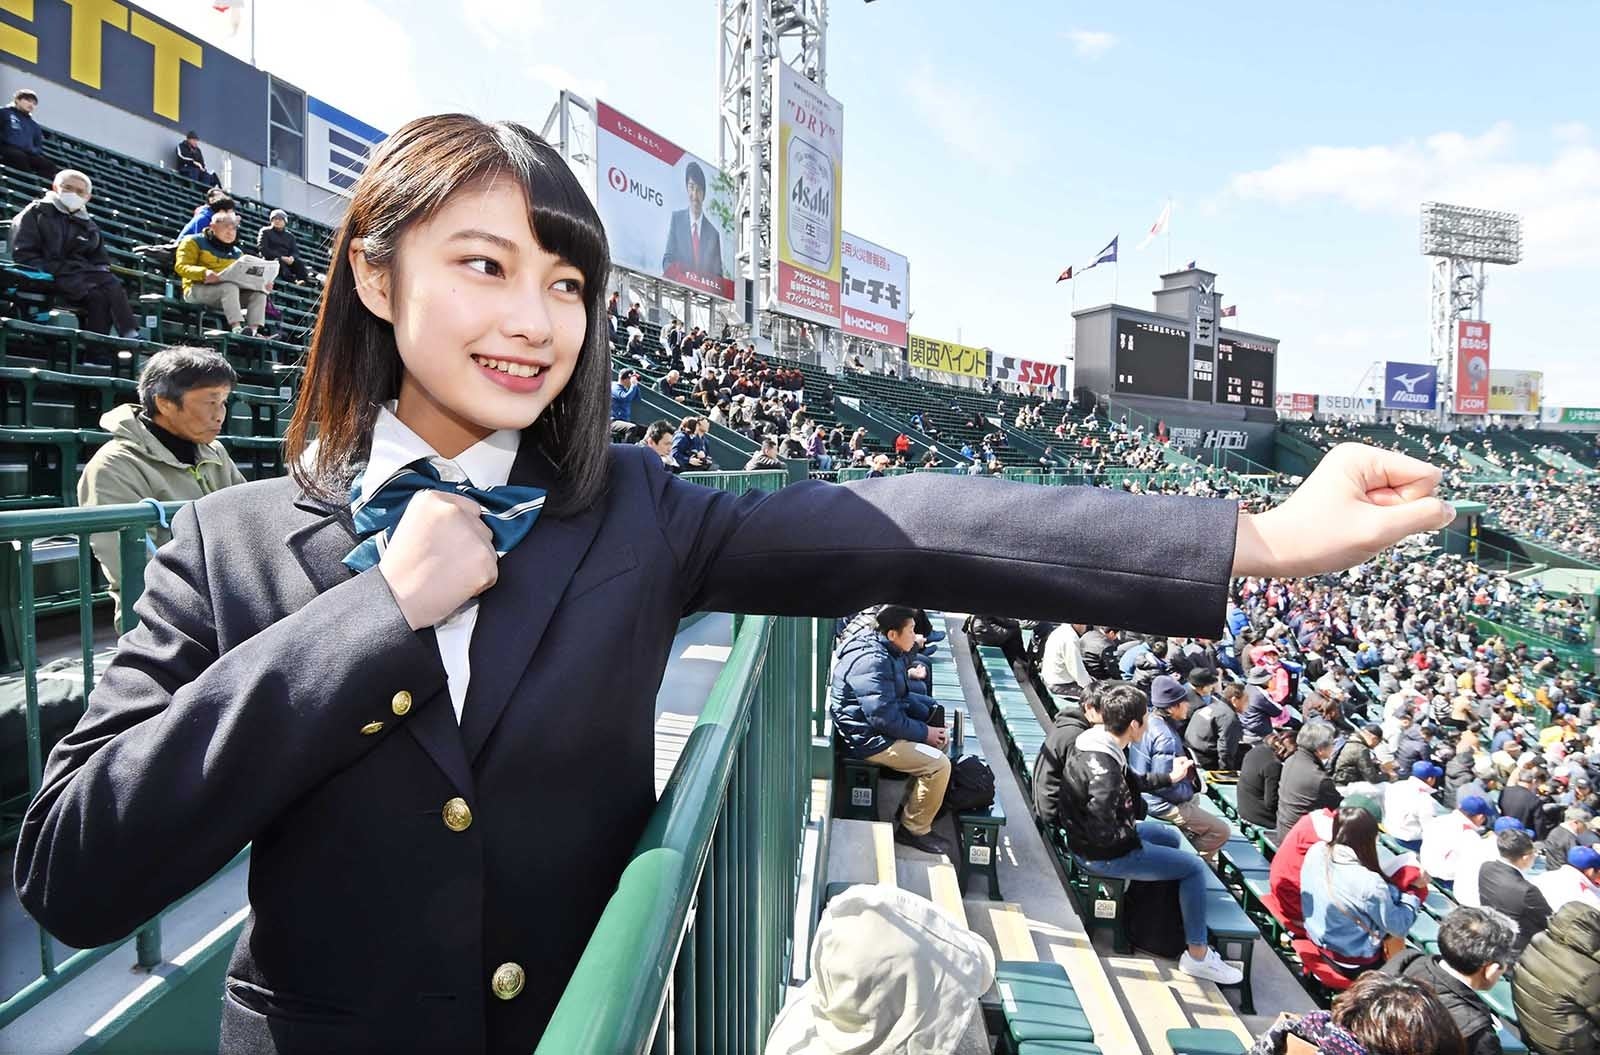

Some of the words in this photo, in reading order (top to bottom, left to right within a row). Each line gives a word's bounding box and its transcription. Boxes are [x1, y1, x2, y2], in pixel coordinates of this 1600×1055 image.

[630, 179, 664, 207] MUFG
[792, 176, 830, 219] Asahi
[910, 337, 985, 375] 関西ペイント
[1018, 360, 1059, 387] SSK
[1326, 395, 1365, 409] SEDIA
